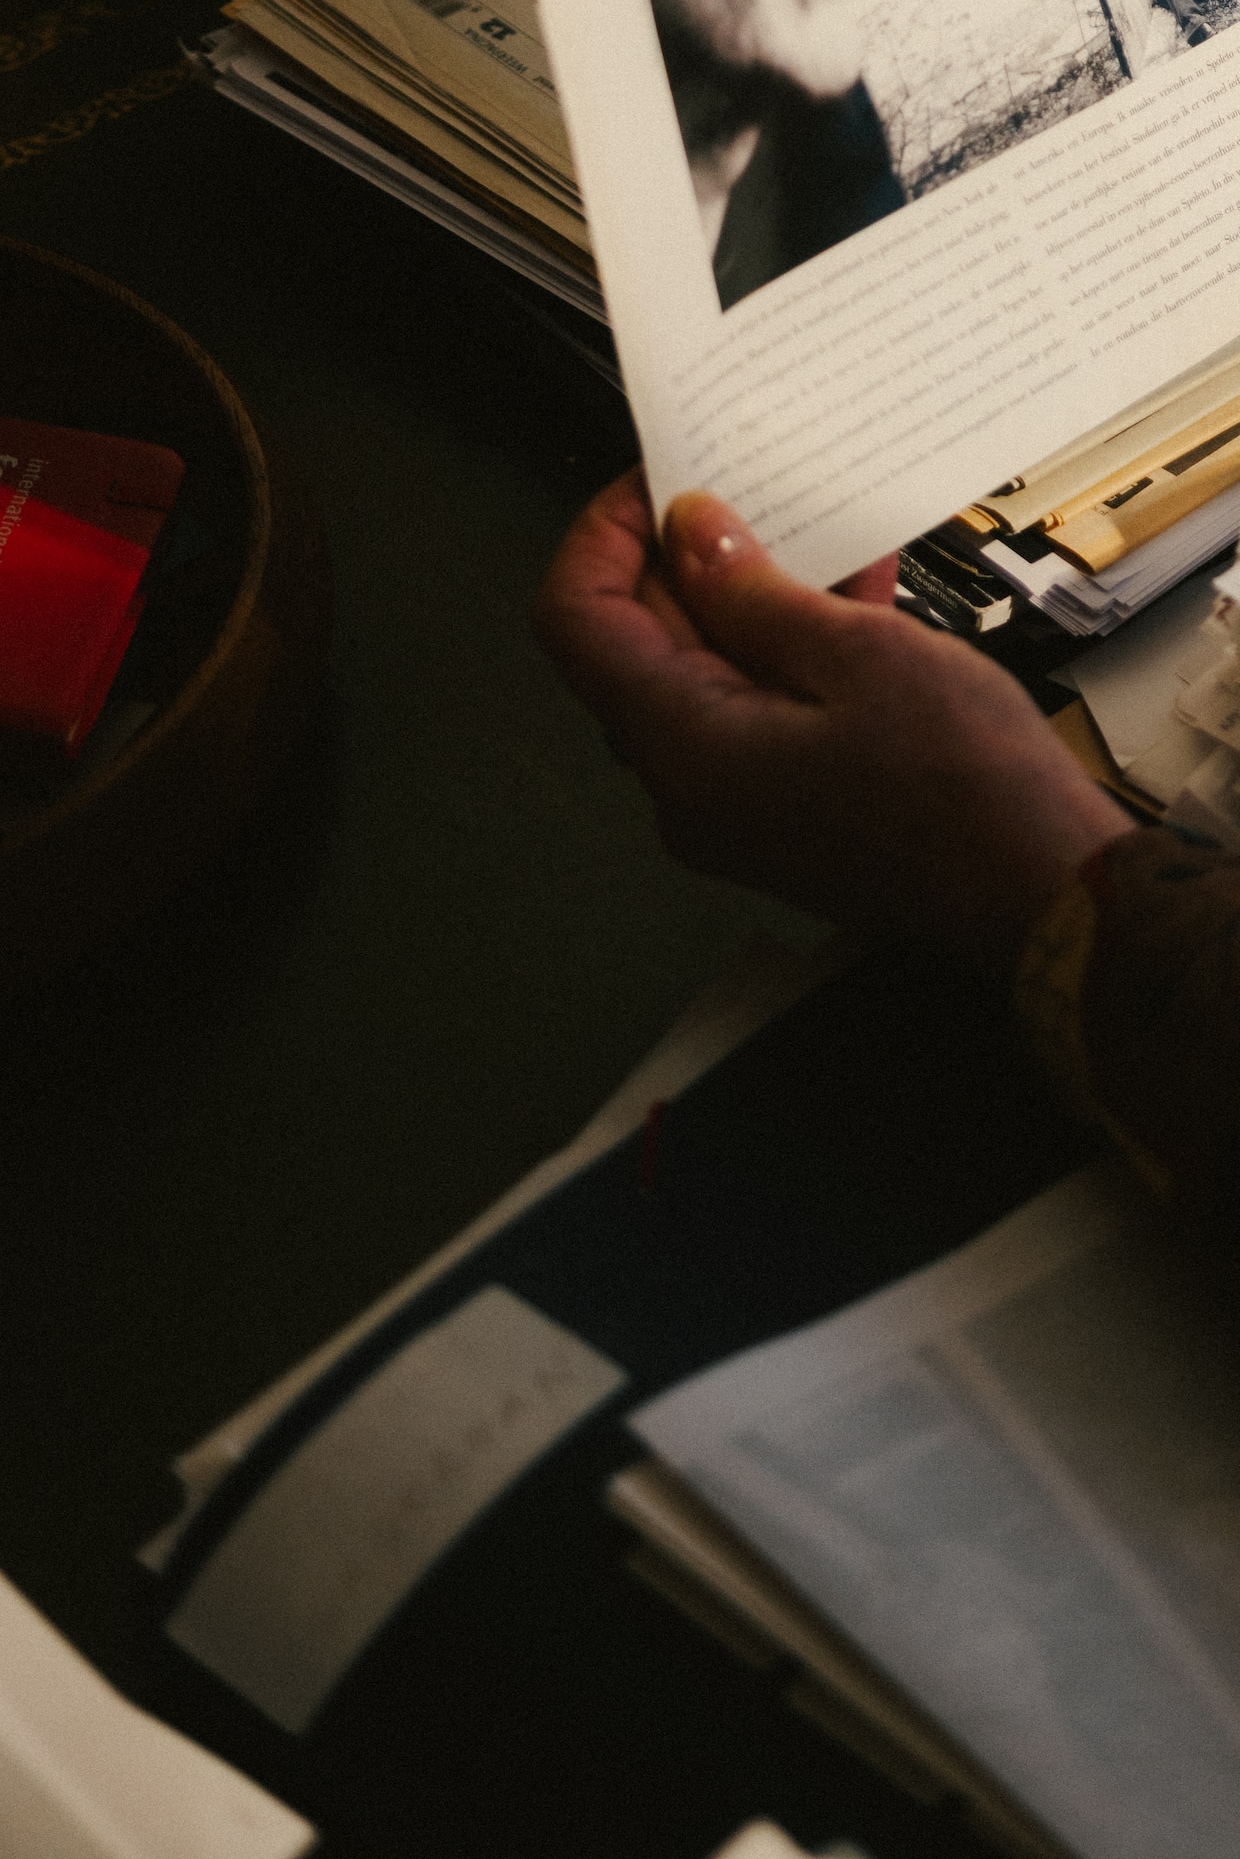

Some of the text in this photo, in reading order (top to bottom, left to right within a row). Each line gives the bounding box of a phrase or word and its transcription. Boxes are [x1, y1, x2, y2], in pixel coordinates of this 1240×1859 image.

[1067, 139, 1078, 150] en
[1117, 109, 1126, 121] Ik
[1129, 95, 1156, 115] maakte
[1159, 74, 1193, 98] vrienden
[1195, 68, 1204, 77] in
[1206, 51, 1234, 72] Spoleto
[1084, 157, 1099, 171] het
[1170, 112, 1180, 126] ga
[1181, 104, 1189, 116] ik
[1191, 101, 1200, 110] er
[1202, 82, 1227, 104] vrijwel
[1148, 154, 1161, 166] van
[1162, 146, 1174, 157] die
[1176, 114, 1225, 149] vriendenclub
[1226, 108, 1240, 120] van
[1106, 212, 1116, 221] in
[1117, 202, 1132, 215] een
[1193, 141, 1236, 170] boerenhuis
[1123, 233, 1135, 244] en
[1135, 226, 1147, 236] de
[1147, 215, 1165, 229] dom
[1167, 206, 1180, 218] van
[1180, 188, 1212, 210] Spoleto.
[1212, 181, 1222, 191] In
[1222, 173, 1234, 184] die
[1126, 260, 1140, 273] ons
[1168, 235, 1181, 247] dat
[1181, 210, 1223, 239] boerenhuis
[1223, 203, 1234, 214] en
[1139, 281, 1158, 297] naar
[1160, 269, 1178, 283] huis
[1205, 243, 1222, 257] naar
[1149, 310, 1163, 322] die
[1164, 271, 1225, 313] hartveroverende
[0, 458, 49, 562] internation
